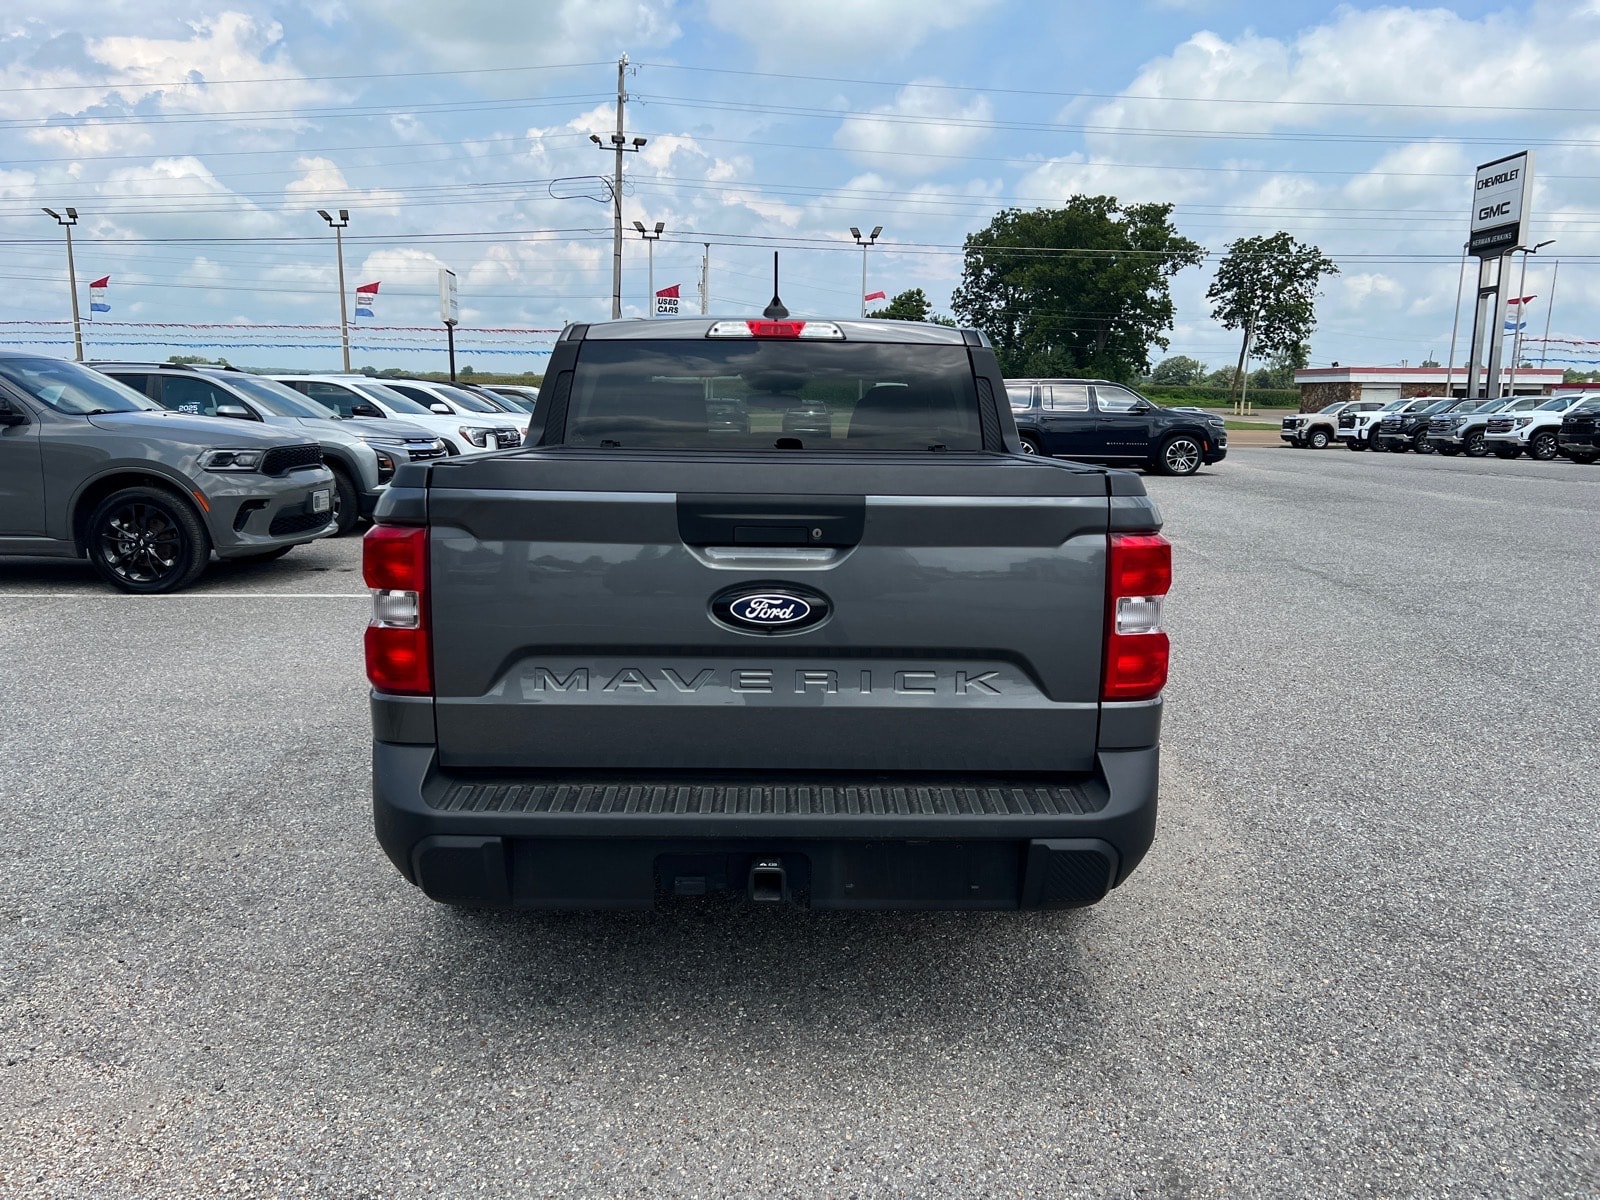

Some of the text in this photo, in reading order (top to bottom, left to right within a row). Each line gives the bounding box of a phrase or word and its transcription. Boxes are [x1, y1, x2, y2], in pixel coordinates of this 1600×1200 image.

[1477, 168, 1520, 190] CHEVROLET
[1479, 201, 1511, 221] GMC
[657, 298, 679, 306] USED
[657, 306, 679, 314] CARS
[745, 598, 795, 619] Ford
[534, 666, 1001, 695] MAVERICK
